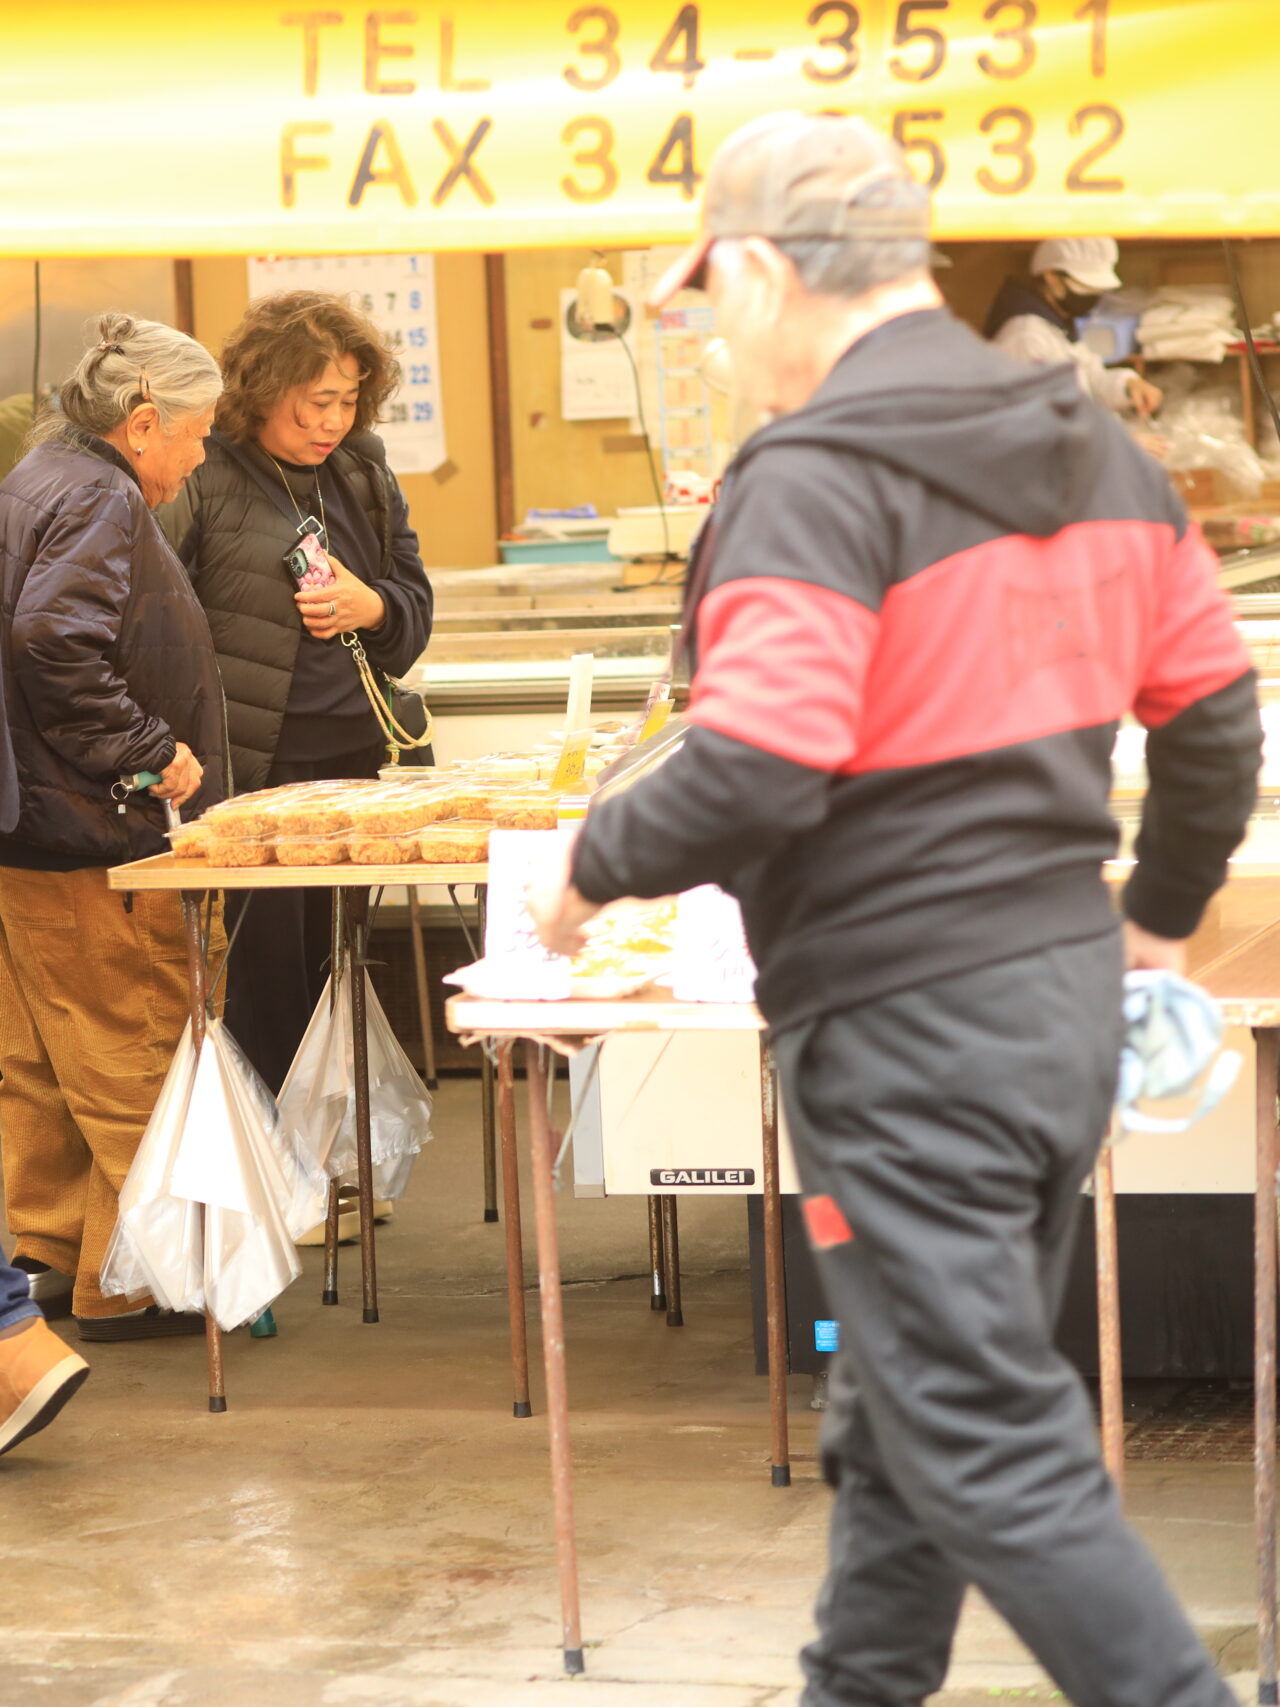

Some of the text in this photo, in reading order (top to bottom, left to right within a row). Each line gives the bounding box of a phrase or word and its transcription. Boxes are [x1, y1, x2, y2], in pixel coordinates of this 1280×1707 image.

[280, 0, 1111, 97] TEL 34-3531
[280, 118, 496, 208] FAX
[384, 291, 397, 311] 7
[410, 290, 421, 310] 8
[408, 328, 428, 347] 15
[409, 364, 431, 385] 22
[660, 1170, 745, 1184] GALILEI
